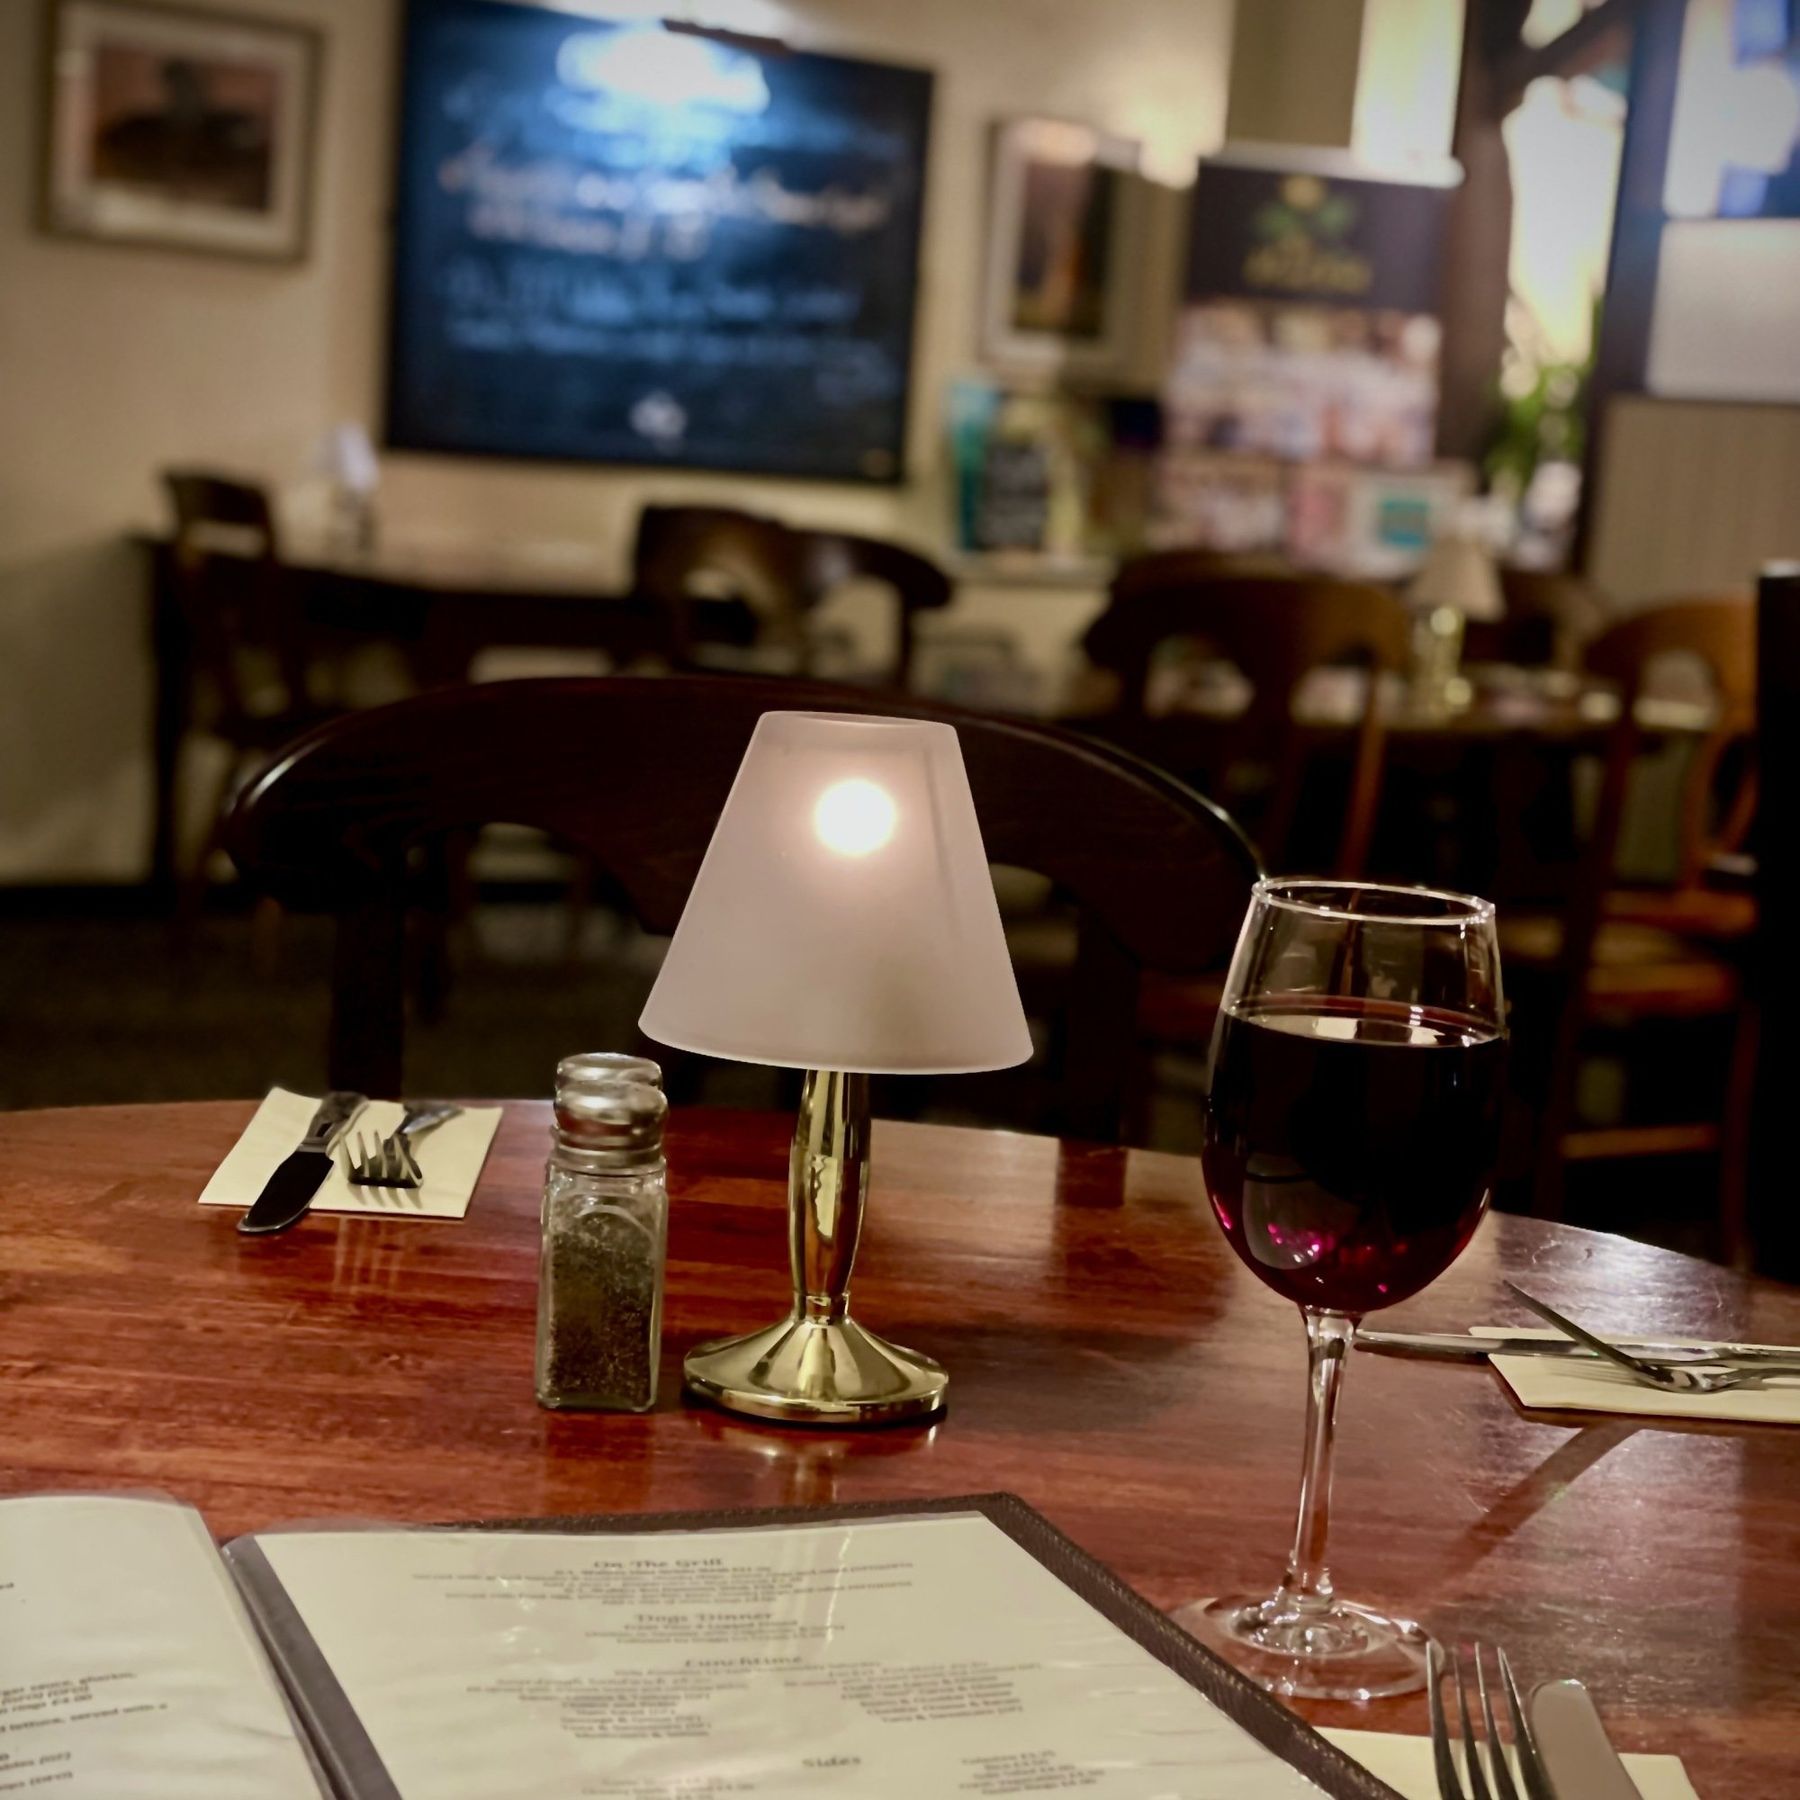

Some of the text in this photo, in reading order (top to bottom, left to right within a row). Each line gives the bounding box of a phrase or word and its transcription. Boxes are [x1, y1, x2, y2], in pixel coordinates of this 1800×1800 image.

[592, 1557, 723, 1569] On The Grill
[695, 1612, 773, 1622] Dinner
[801, 1754, 863, 1768] Sides
